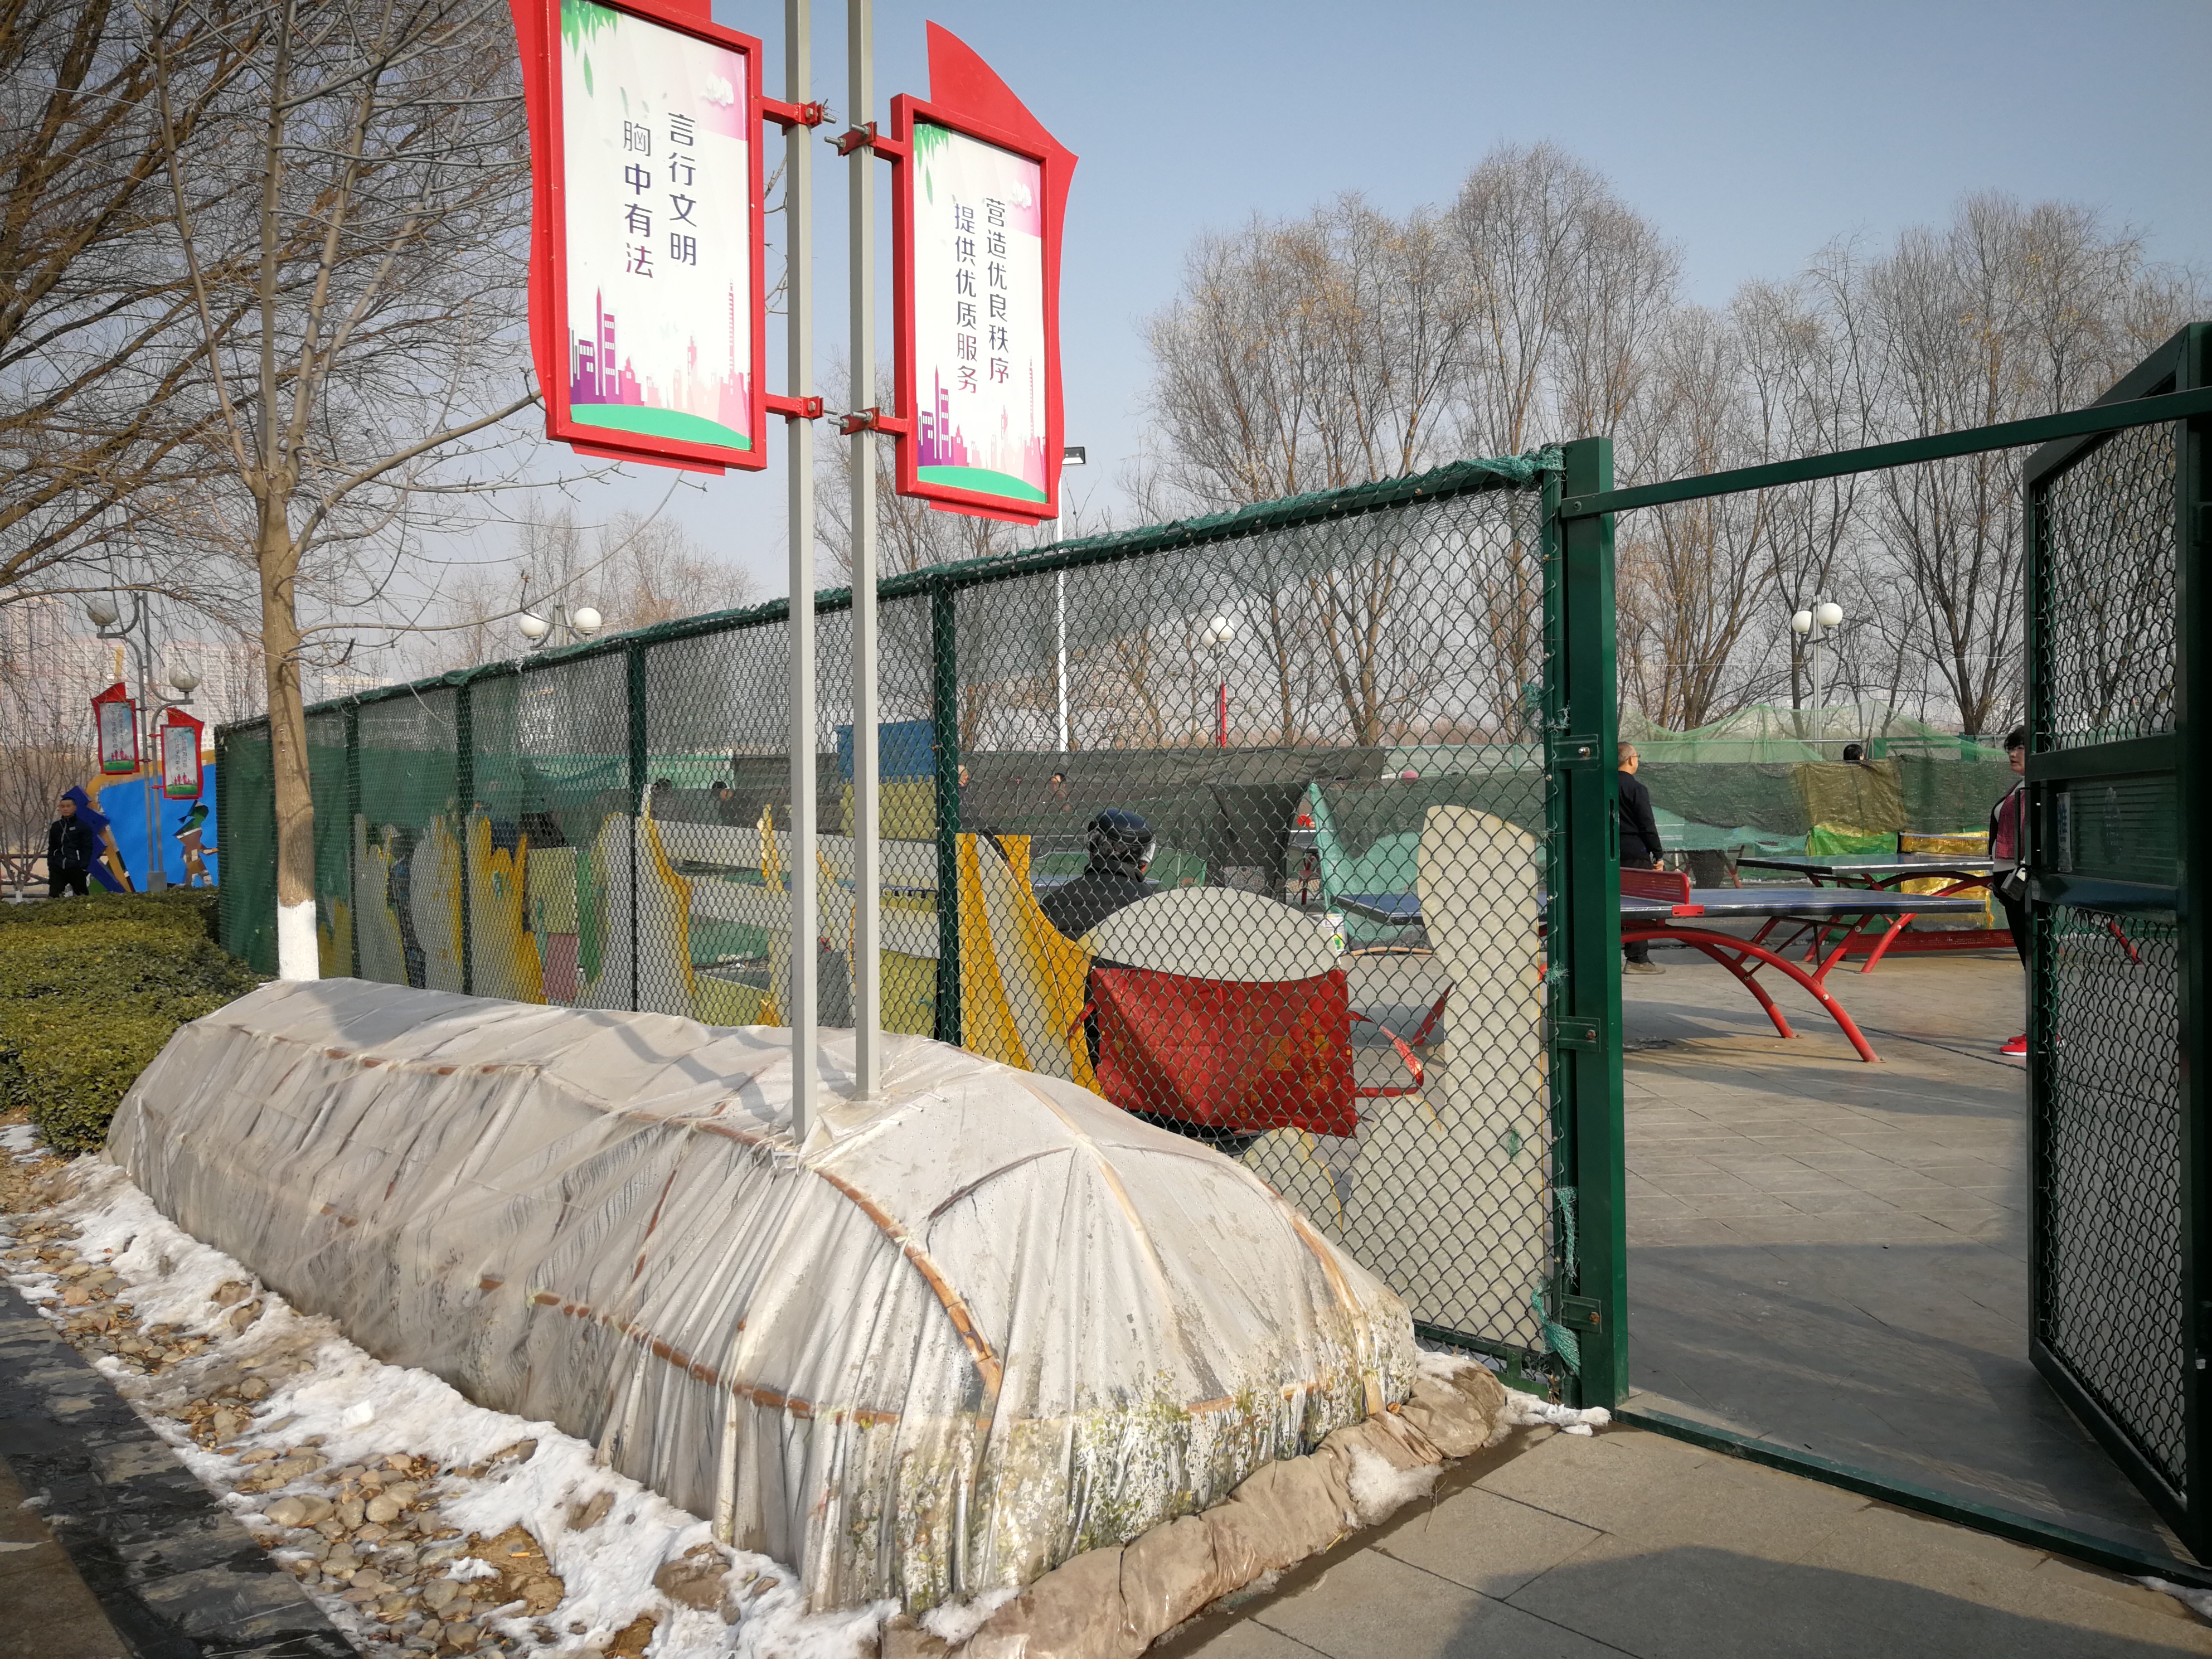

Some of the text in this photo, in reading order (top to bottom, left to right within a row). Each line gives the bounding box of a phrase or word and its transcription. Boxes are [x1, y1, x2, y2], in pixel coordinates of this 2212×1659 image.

[623, 120, 654, 279] 胸中有法
[668, 112, 697, 266] 言行文明
[954, 202, 978, 394] 提供优质服务
[986, 197, 1009, 384] 营造优良秩序
